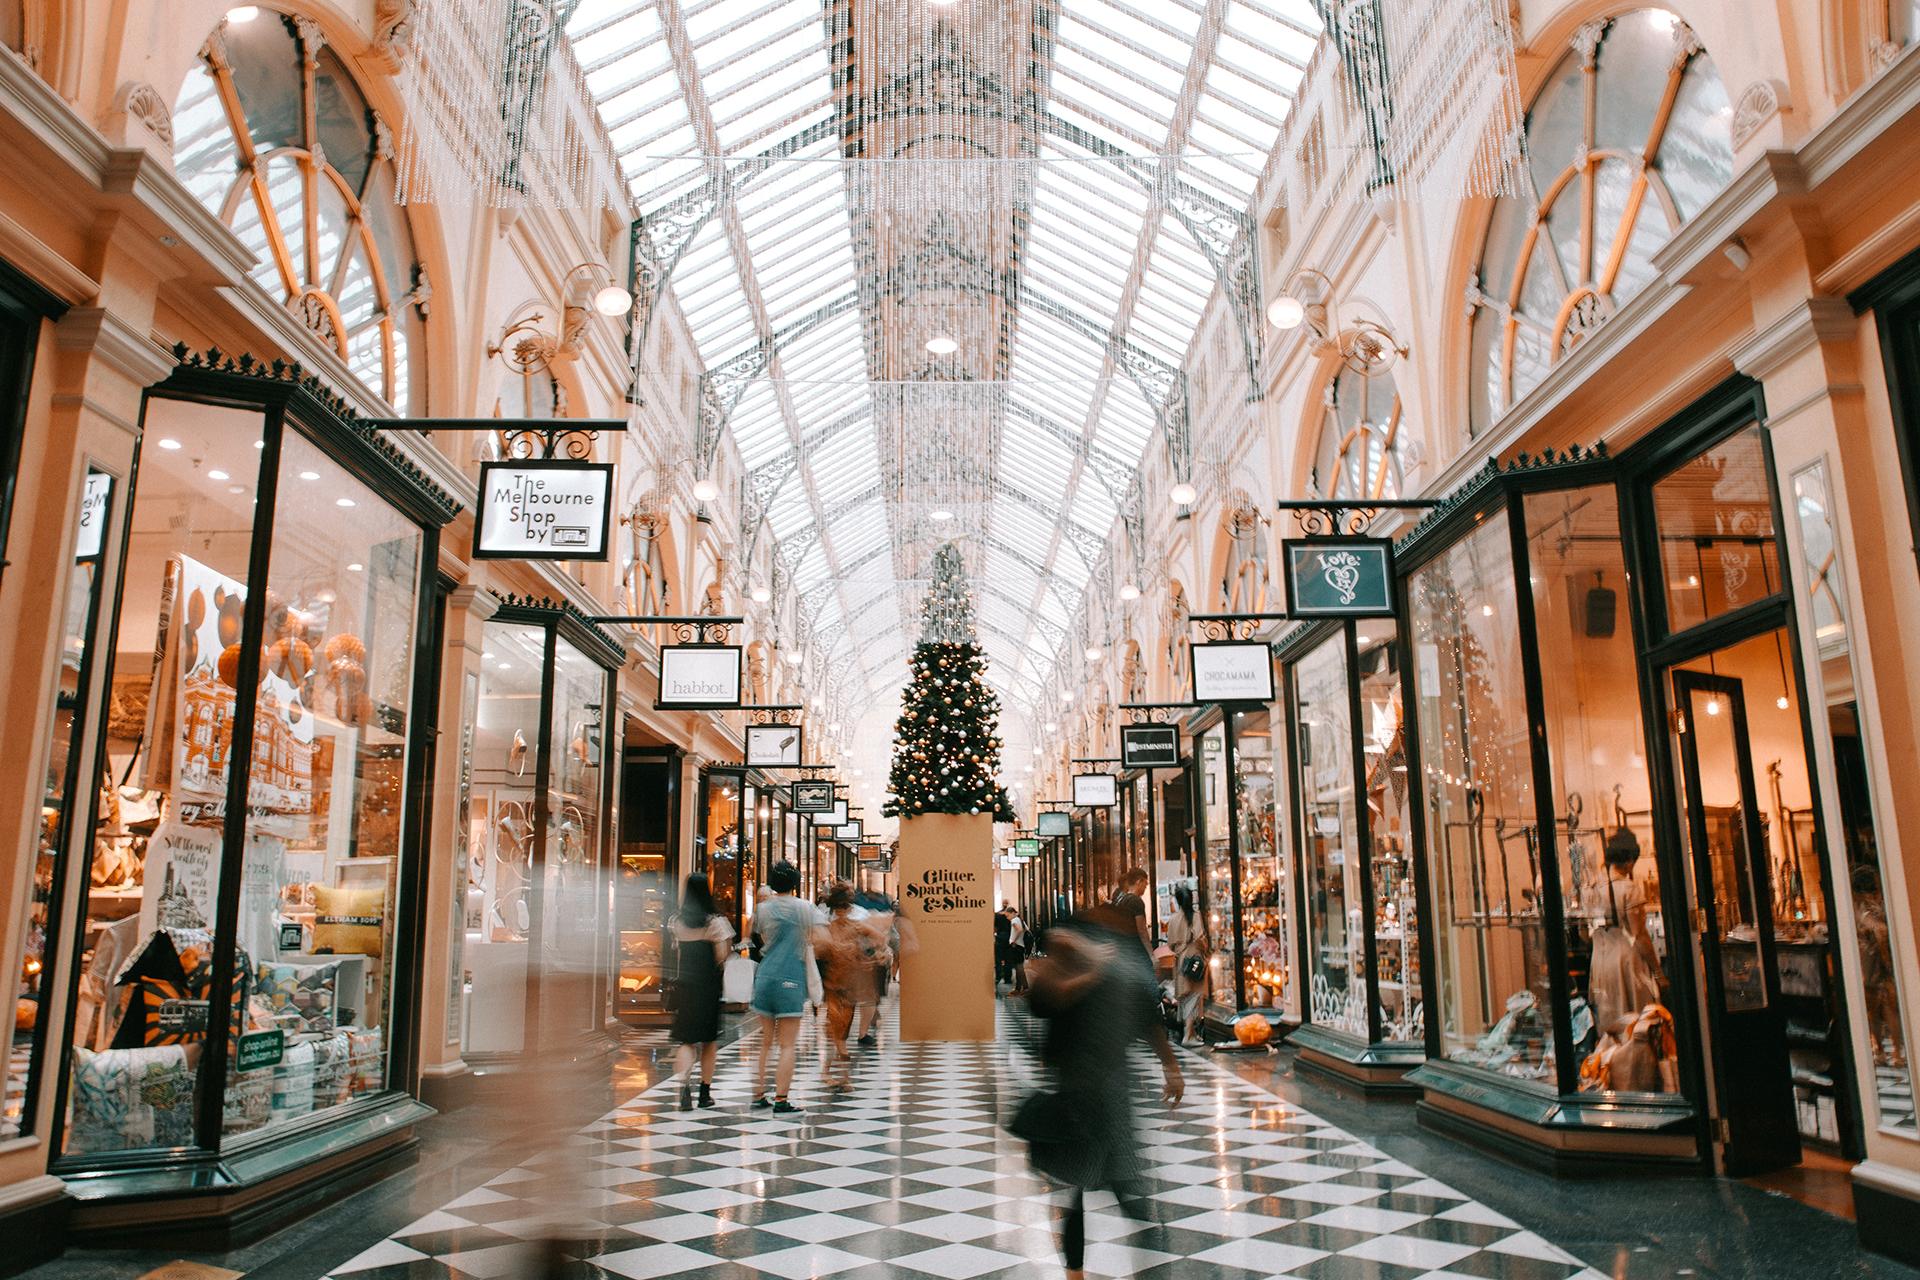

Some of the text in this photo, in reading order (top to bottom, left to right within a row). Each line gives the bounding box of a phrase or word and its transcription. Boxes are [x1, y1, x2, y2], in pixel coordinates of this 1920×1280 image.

[514, 475, 545, 490] The
[494, 488, 594, 505] Melbourne
[509, 506, 556, 527] Shop
[525, 527, 548, 544] by
[1203, 671, 1257, 681] CHOCAMAMA
[672, 680, 728, 695] habbot.
[1127, 741, 1173, 753] ESTMINSTER
[923, 869, 976, 885] Glitter.
[906, 883, 964, 898] Sparkle
[923, 895, 986, 913] & Shine
